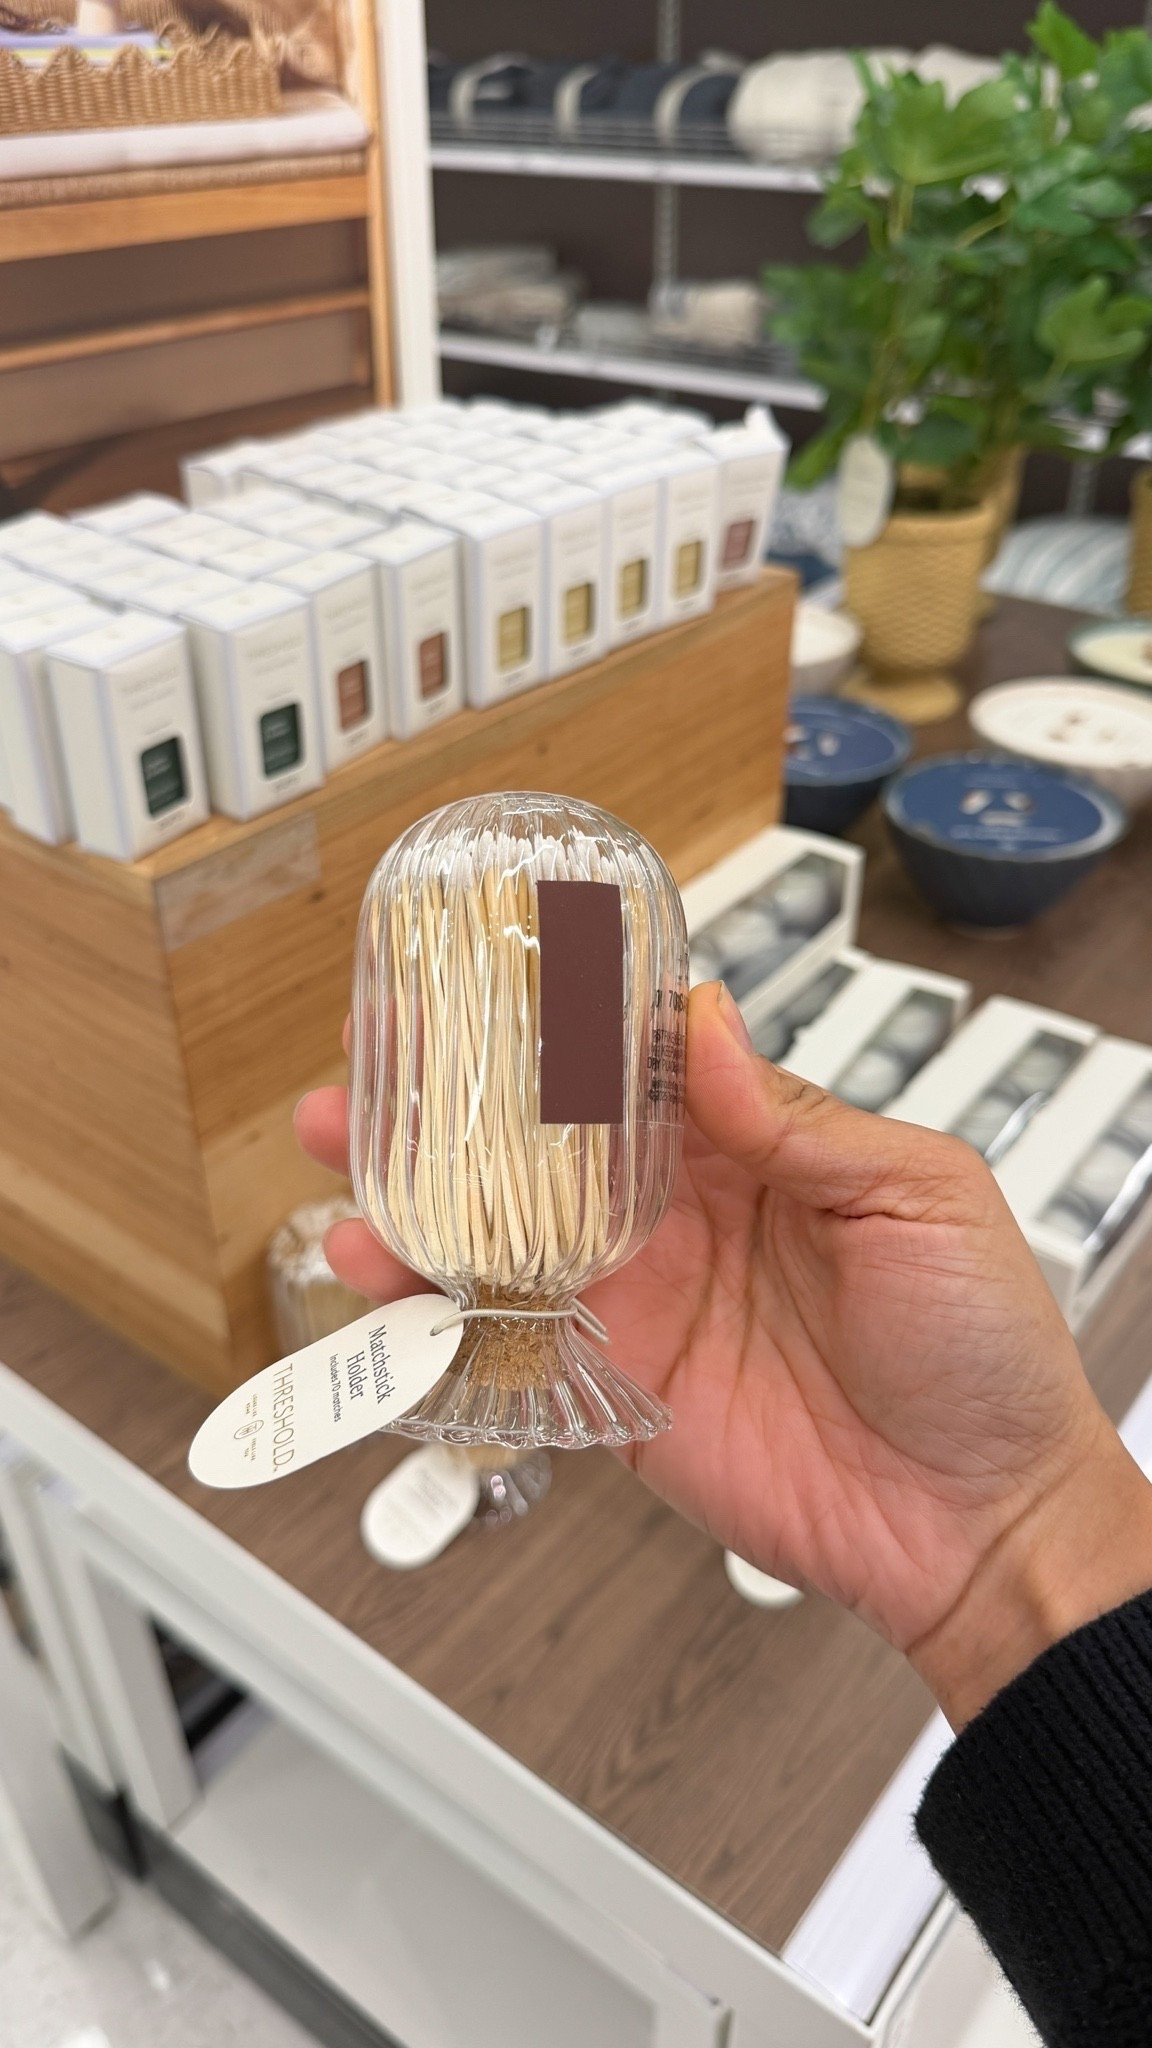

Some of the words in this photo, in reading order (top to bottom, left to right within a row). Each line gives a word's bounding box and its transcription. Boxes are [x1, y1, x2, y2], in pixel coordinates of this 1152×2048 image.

[329, 1353, 339, 1381] Includes
[346, 1350, 368, 1400] Holder
[368, 1324, 396, 1404] Matchstick
[331, 1380, 341, 1391] 70
[273, 1363, 295, 1467] THRESHOLD
[332, 1391, 341, 1423] matches
